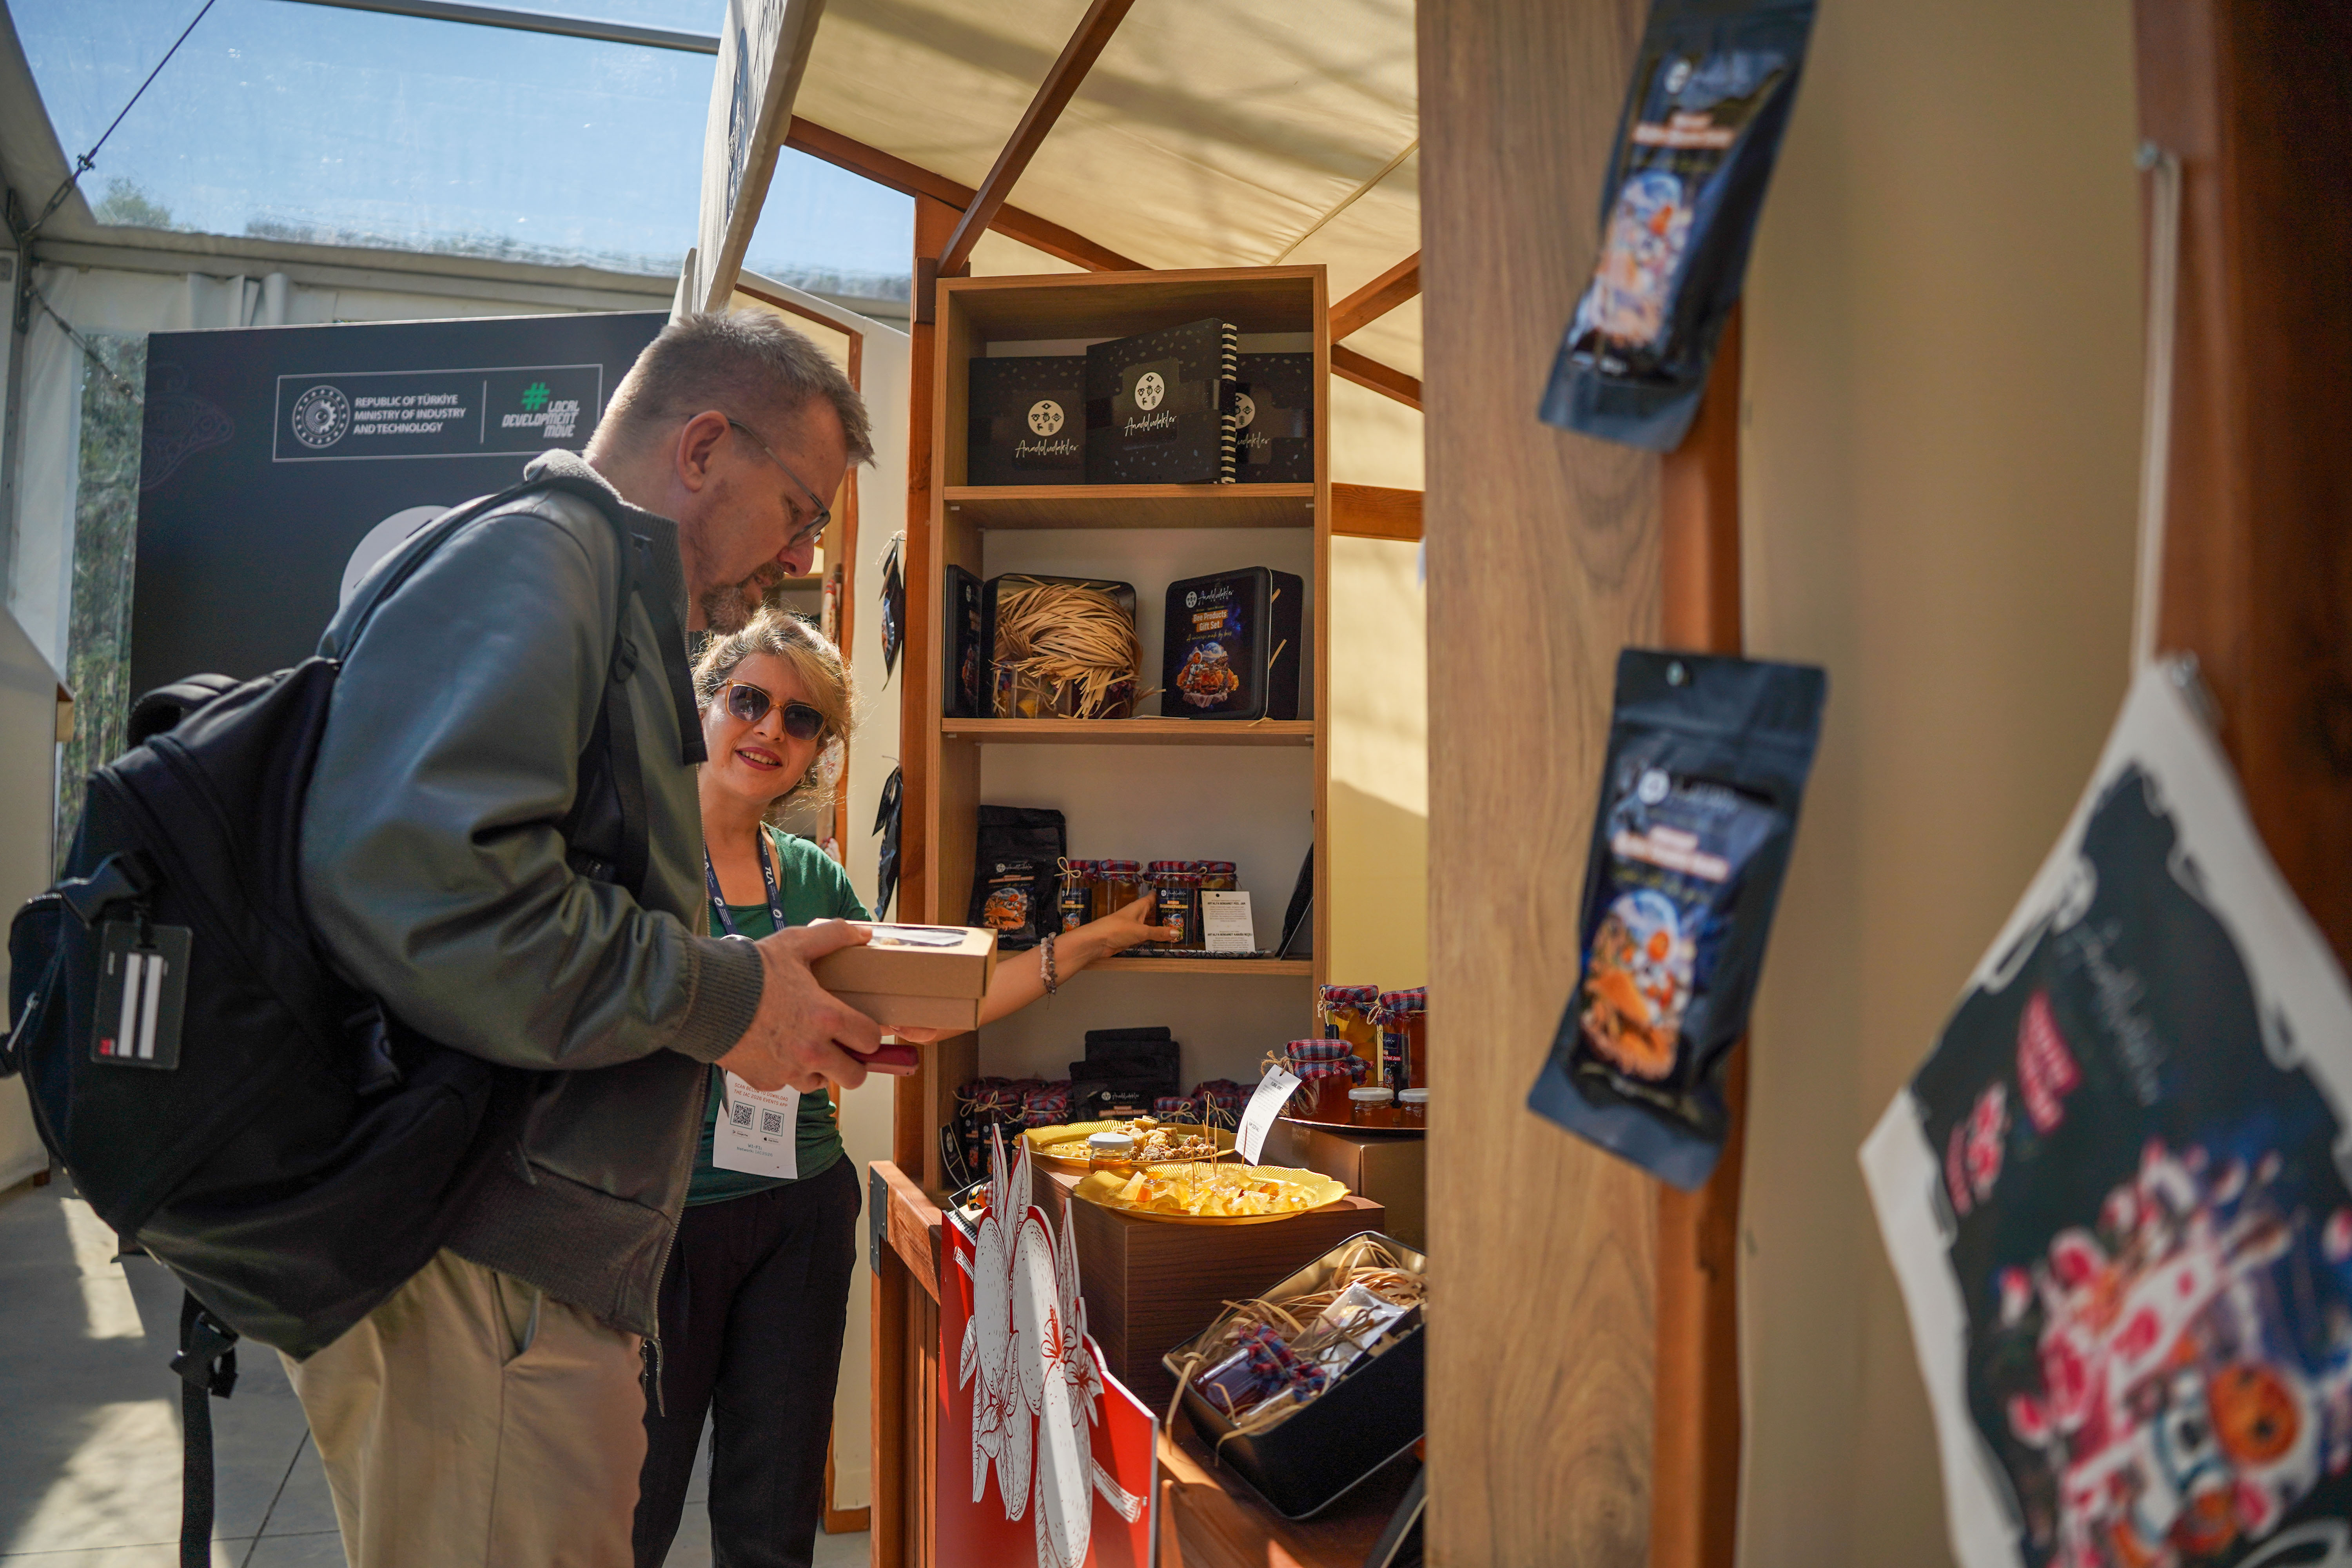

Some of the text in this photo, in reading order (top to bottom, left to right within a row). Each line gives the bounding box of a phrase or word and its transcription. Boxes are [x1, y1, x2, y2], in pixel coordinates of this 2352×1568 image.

[354, 393, 458, 408] REPUBLIC OF TÜRKİYE
[548, 400, 580, 412] LOCAL
[354, 408, 466, 421] MINISTRY OF INDUSTRY
[502, 412, 579, 427] DEVELOPMENT
[353, 422, 443, 435] AND TECHNOLOGY
[543, 425, 576, 438] MOVE
[1204, 611, 1227, 620] Products
[1200, 621, 1220, 631] Gift Set
[767, 1092, 788, 1101] DOWNLOAD
